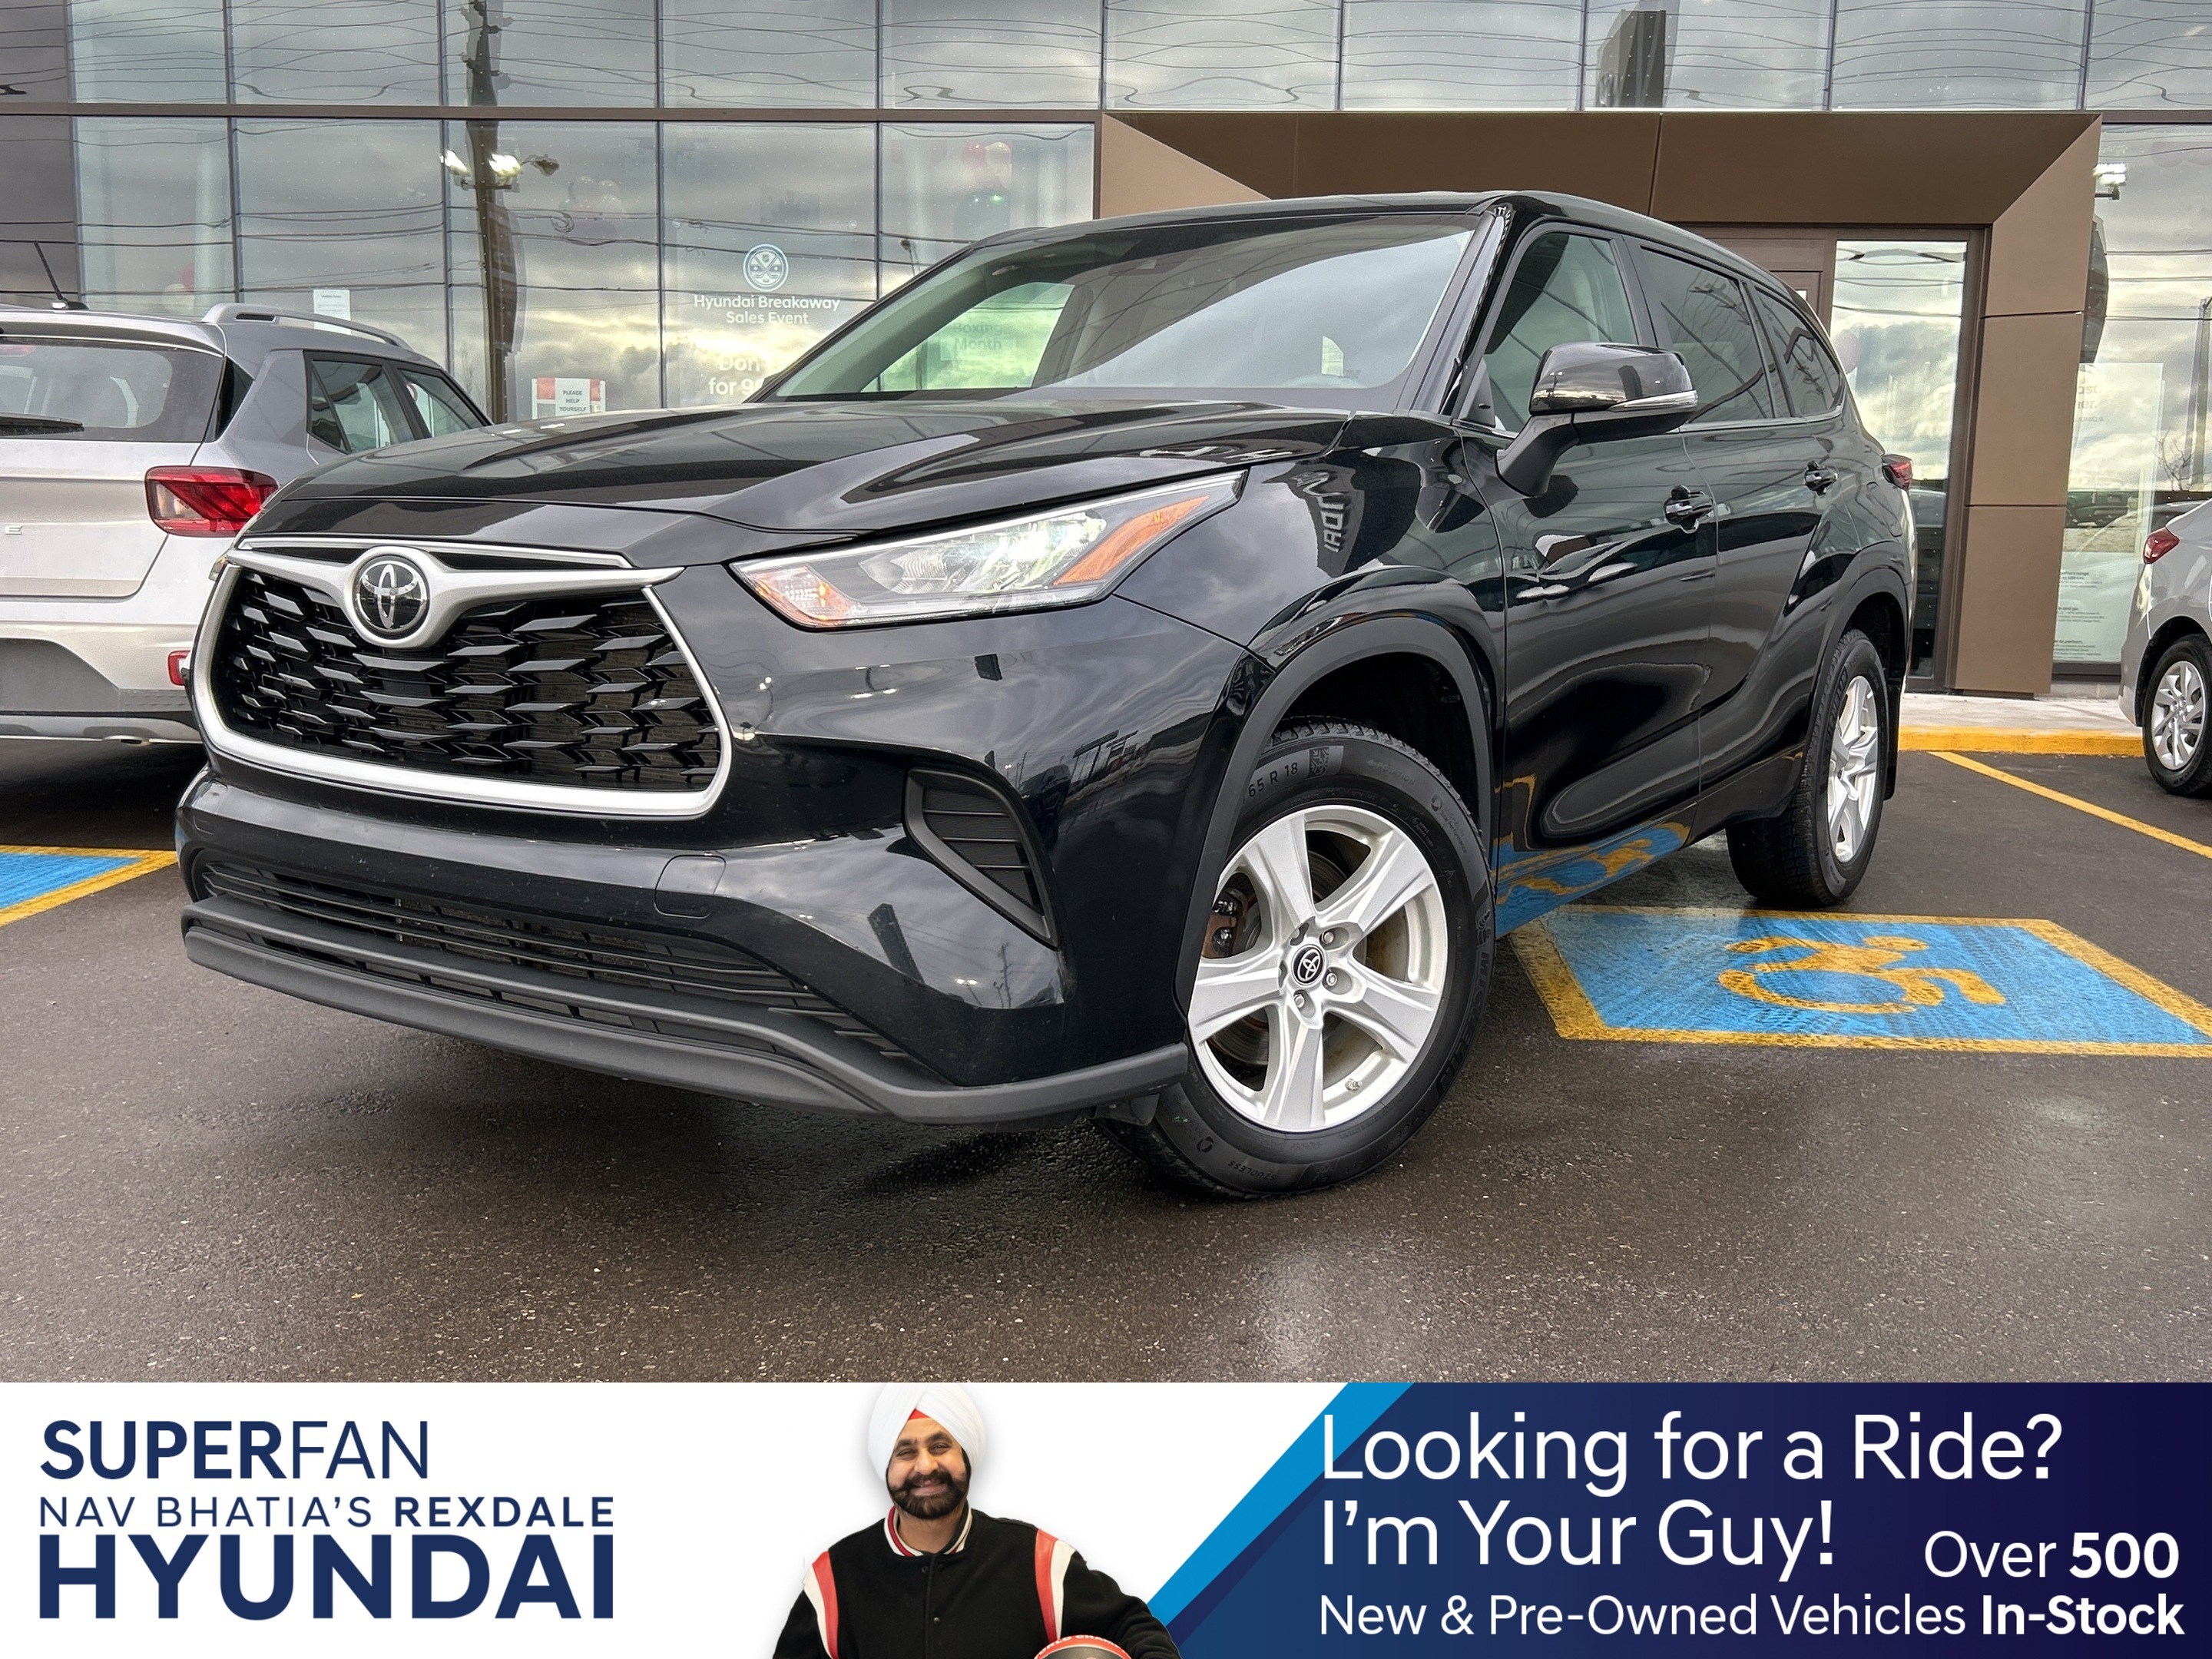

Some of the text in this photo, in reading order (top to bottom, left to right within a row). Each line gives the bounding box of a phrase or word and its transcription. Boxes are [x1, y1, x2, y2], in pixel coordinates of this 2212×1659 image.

[694, 295, 840, 311] Hyundai Breakaway
[726, 311, 809, 324] Sales Event
[708, 377, 738, 395] for
[1248, 762, 1298, 797] 65 R 18
[1227, 1160, 1277, 1181] STUDLESS
